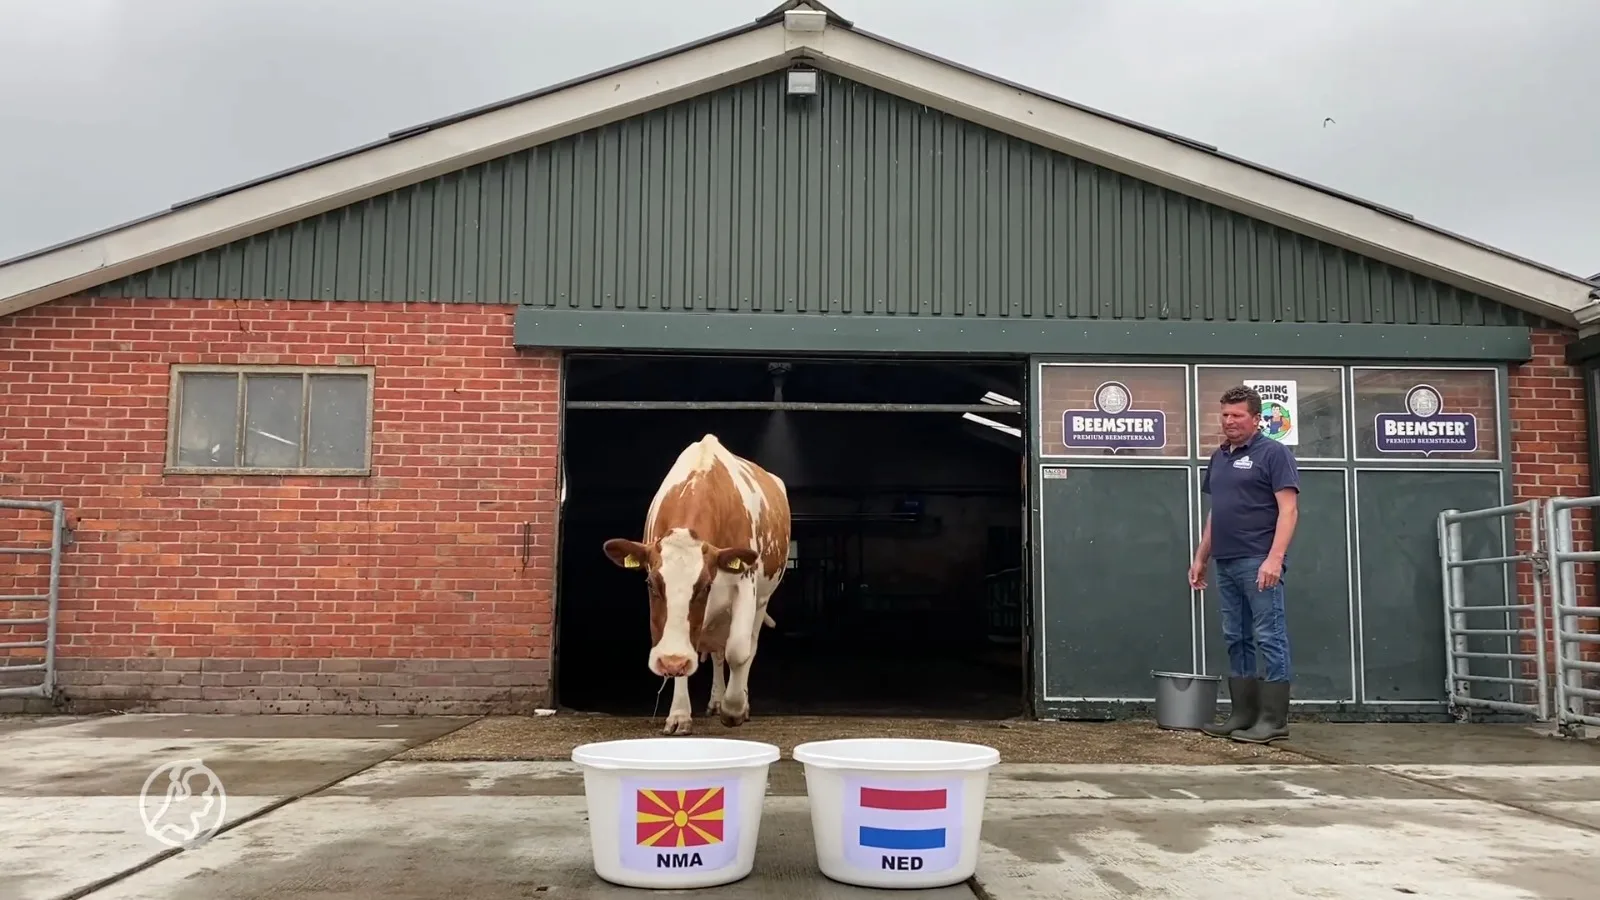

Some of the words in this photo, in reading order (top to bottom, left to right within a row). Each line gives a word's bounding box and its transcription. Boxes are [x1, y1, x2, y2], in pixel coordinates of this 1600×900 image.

[1072, 416, 1154, 433] BEEMSTER
[1384, 419, 1466, 436] BEEMSTER
[656, 852, 703, 868] NMA
[881, 855, 924, 871] NED
